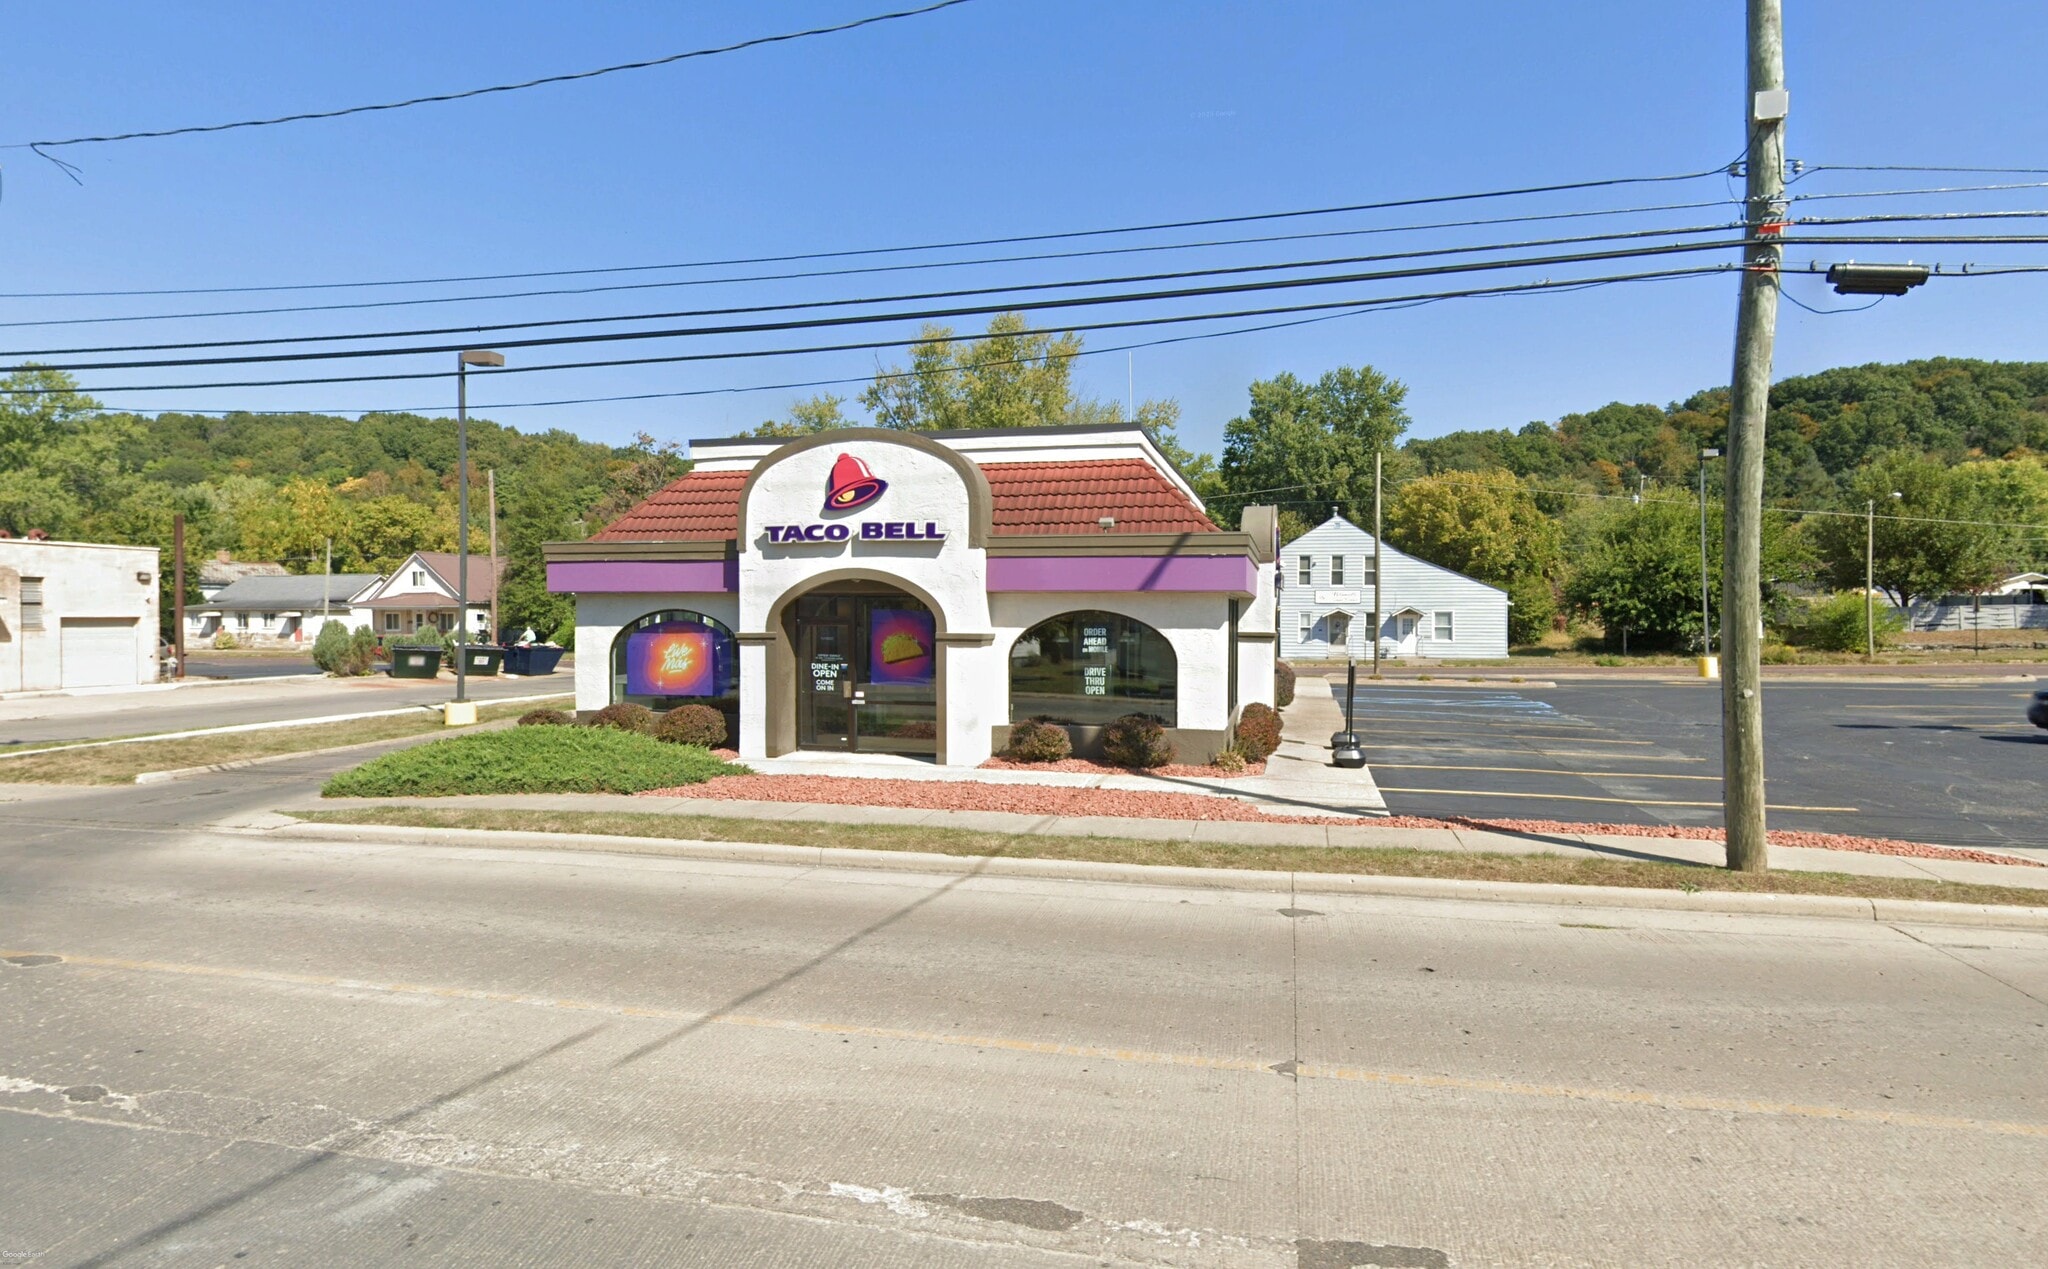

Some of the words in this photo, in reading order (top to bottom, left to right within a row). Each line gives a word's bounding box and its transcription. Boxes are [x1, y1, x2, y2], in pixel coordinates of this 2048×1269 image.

[764, 524, 850, 542] TACO
[861, 522, 946, 539] BELL
[1083, 628, 1107, 636] ORDER
[1083, 637, 1107, 645] AHEAD
[1084, 667, 1106, 676] DRIVE
[1085, 677, 1105, 685] THRU
[1085, 686, 1105, 695] OPEN
